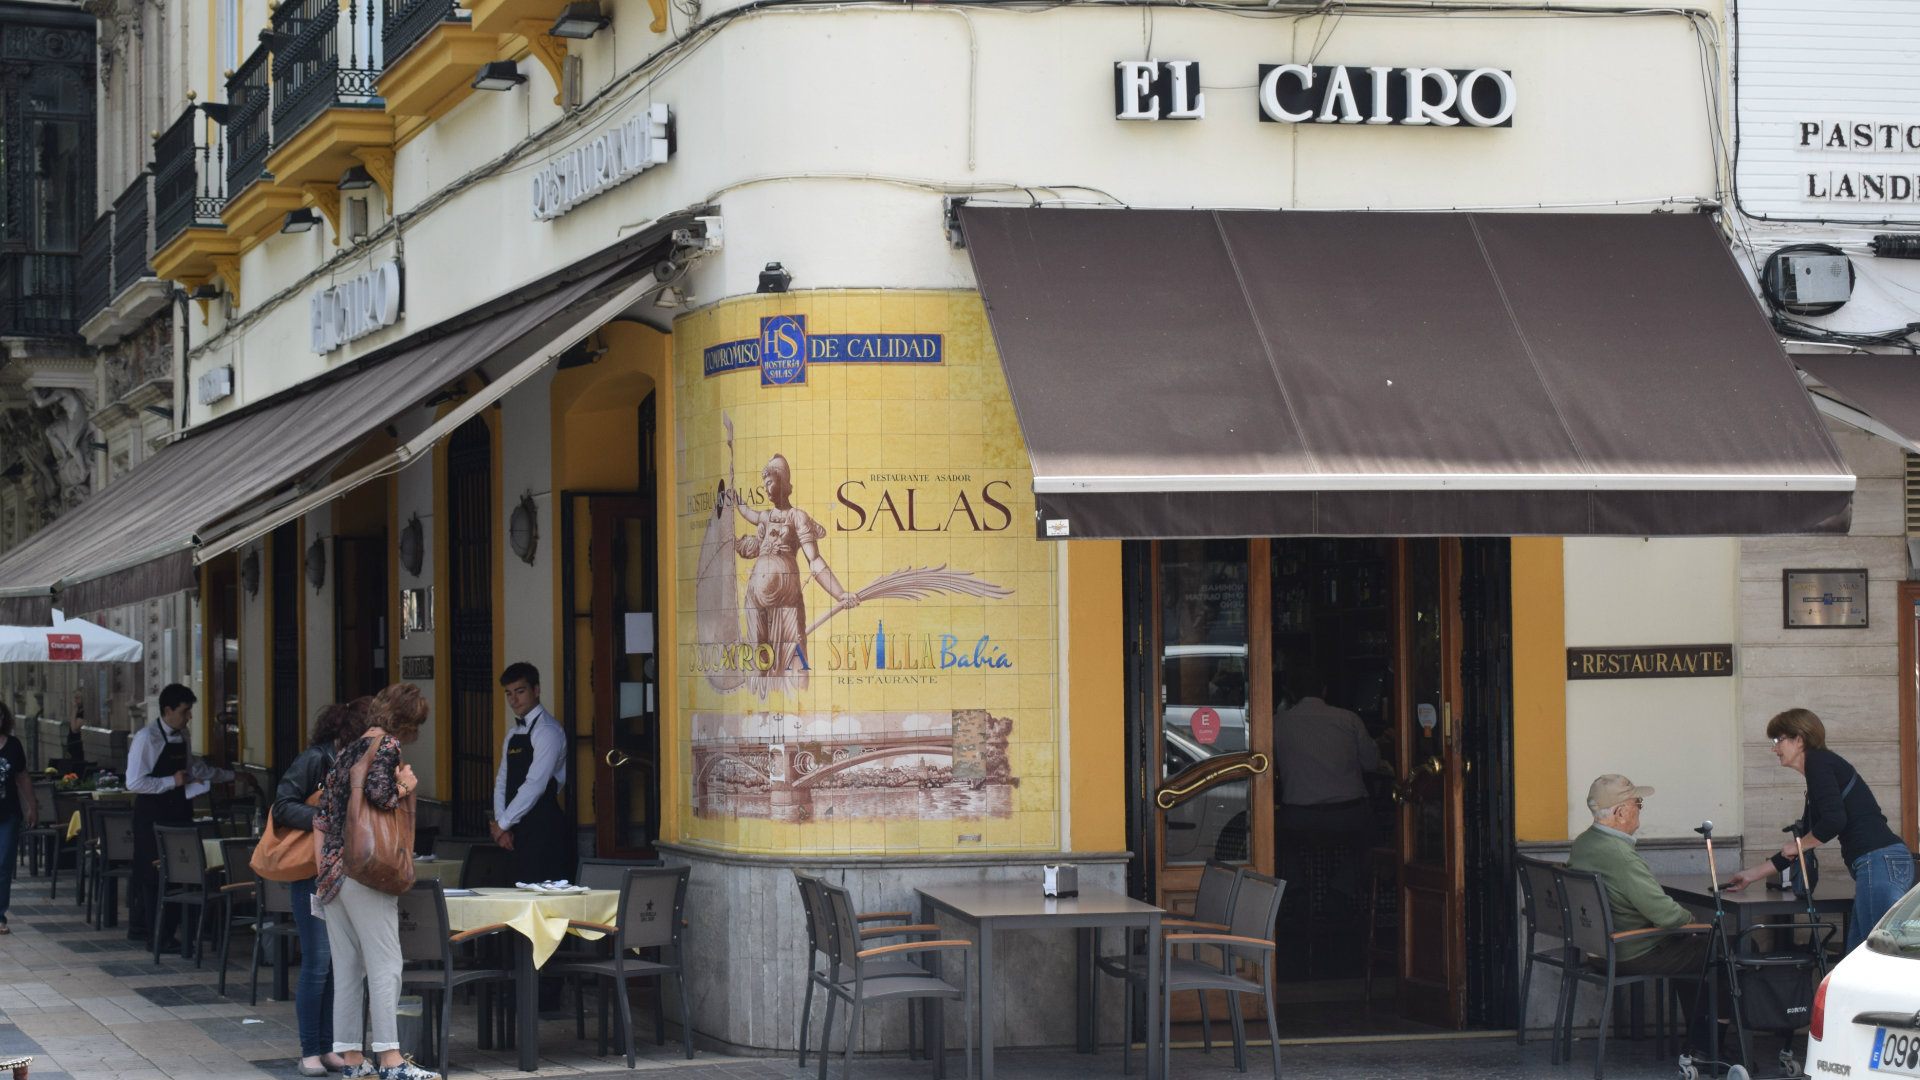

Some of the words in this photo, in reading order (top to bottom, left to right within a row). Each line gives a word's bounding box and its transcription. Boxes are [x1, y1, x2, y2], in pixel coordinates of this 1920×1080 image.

[1116, 57, 1205, 122] EL
[1259, 62, 1517, 127] CAIRO
[1806, 173, 1920, 200] LAND
[764, 322, 799, 359] HS
[704, 342, 760, 371] COMPROMISO
[811, 338, 839, 358] DE
[847, 338, 936, 358] CALIDAD
[768, 369, 793, 379] SALAS
[869, 473, 930, 483] RESTAURANTE
[934, 473, 972, 483] ASADOR
[836, 480, 1012, 532] SALAS
[827, 624, 936, 671] SEVILLA
[1582, 651, 1724, 676] RESTAURANTE
[837, 675, 938, 685] RESTAURANTE
[1201, 713, 1210, 726] E
[1816, 1059, 1852, 1077] PEUGEOT
